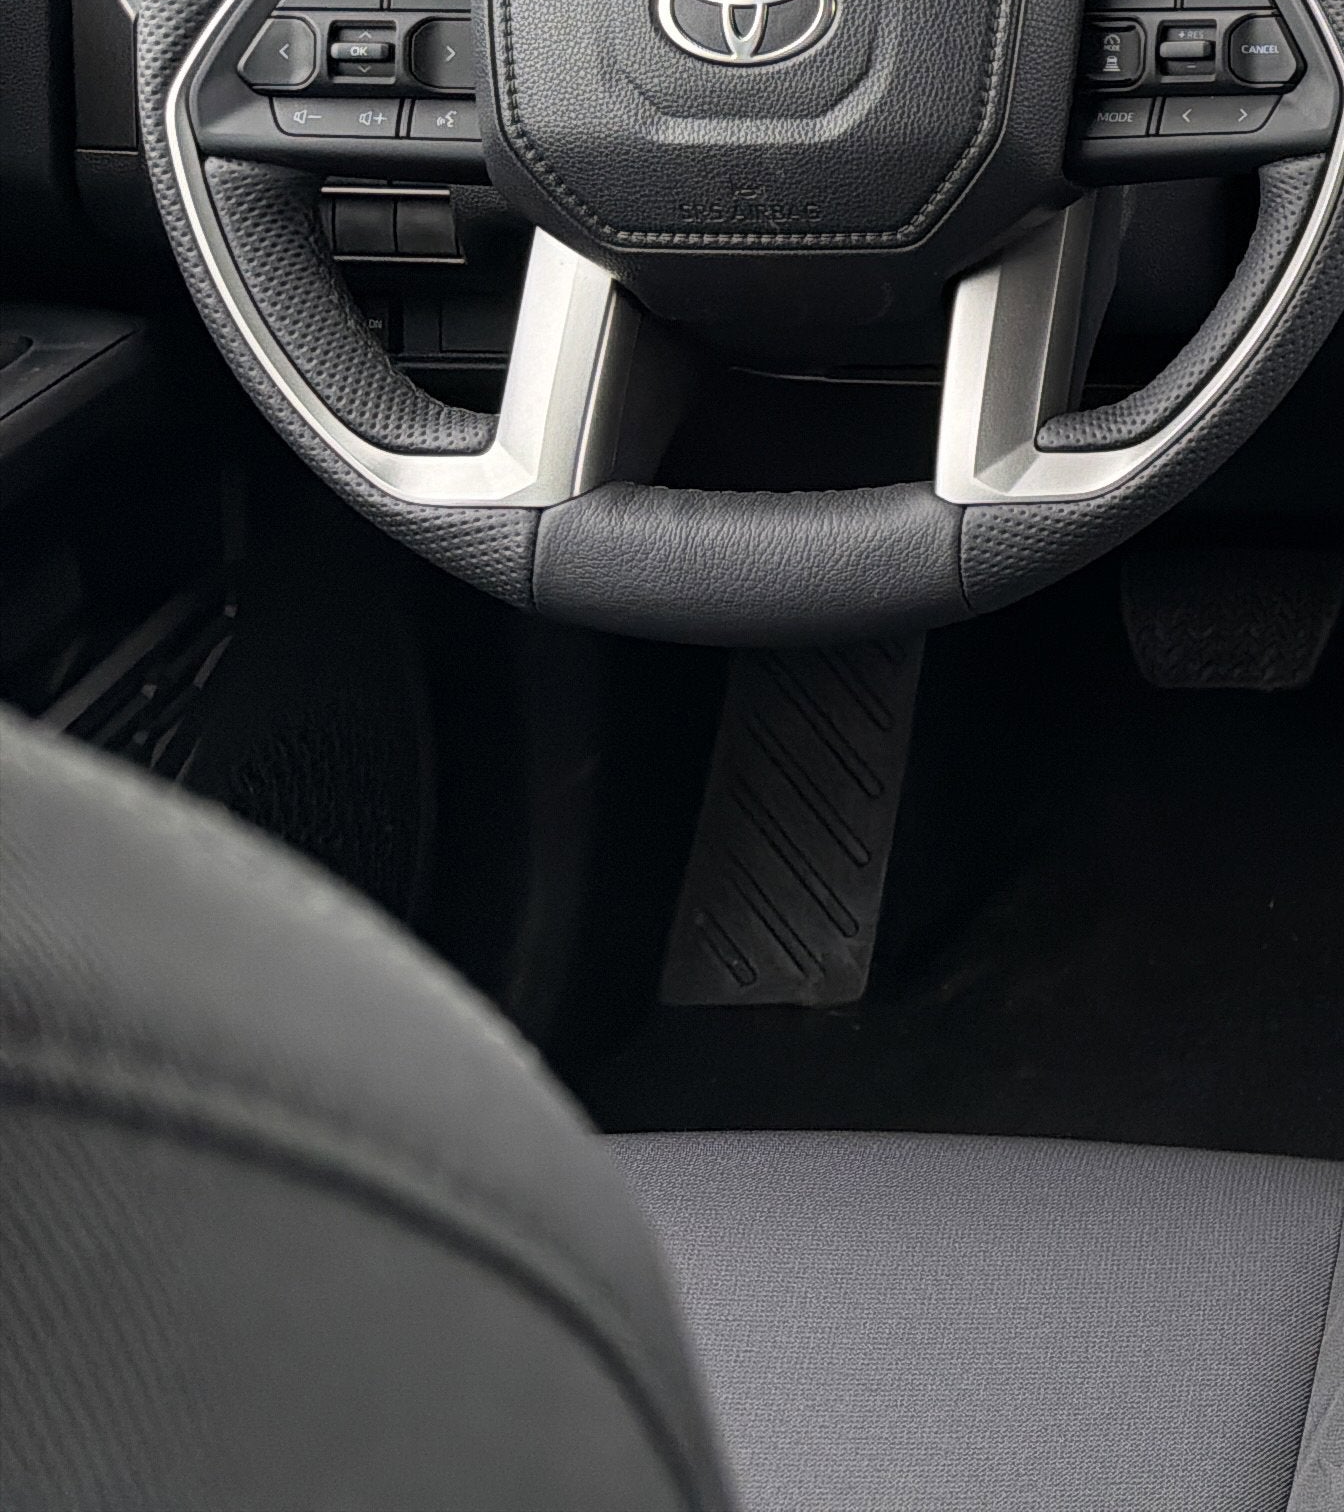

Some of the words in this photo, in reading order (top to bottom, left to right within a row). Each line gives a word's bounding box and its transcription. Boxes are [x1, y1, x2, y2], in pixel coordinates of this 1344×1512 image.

[350, 46, 368, 57] OK
[1241, 44, 1279, 54] CANCEL
[1097, 112, 1135, 123] MODE
